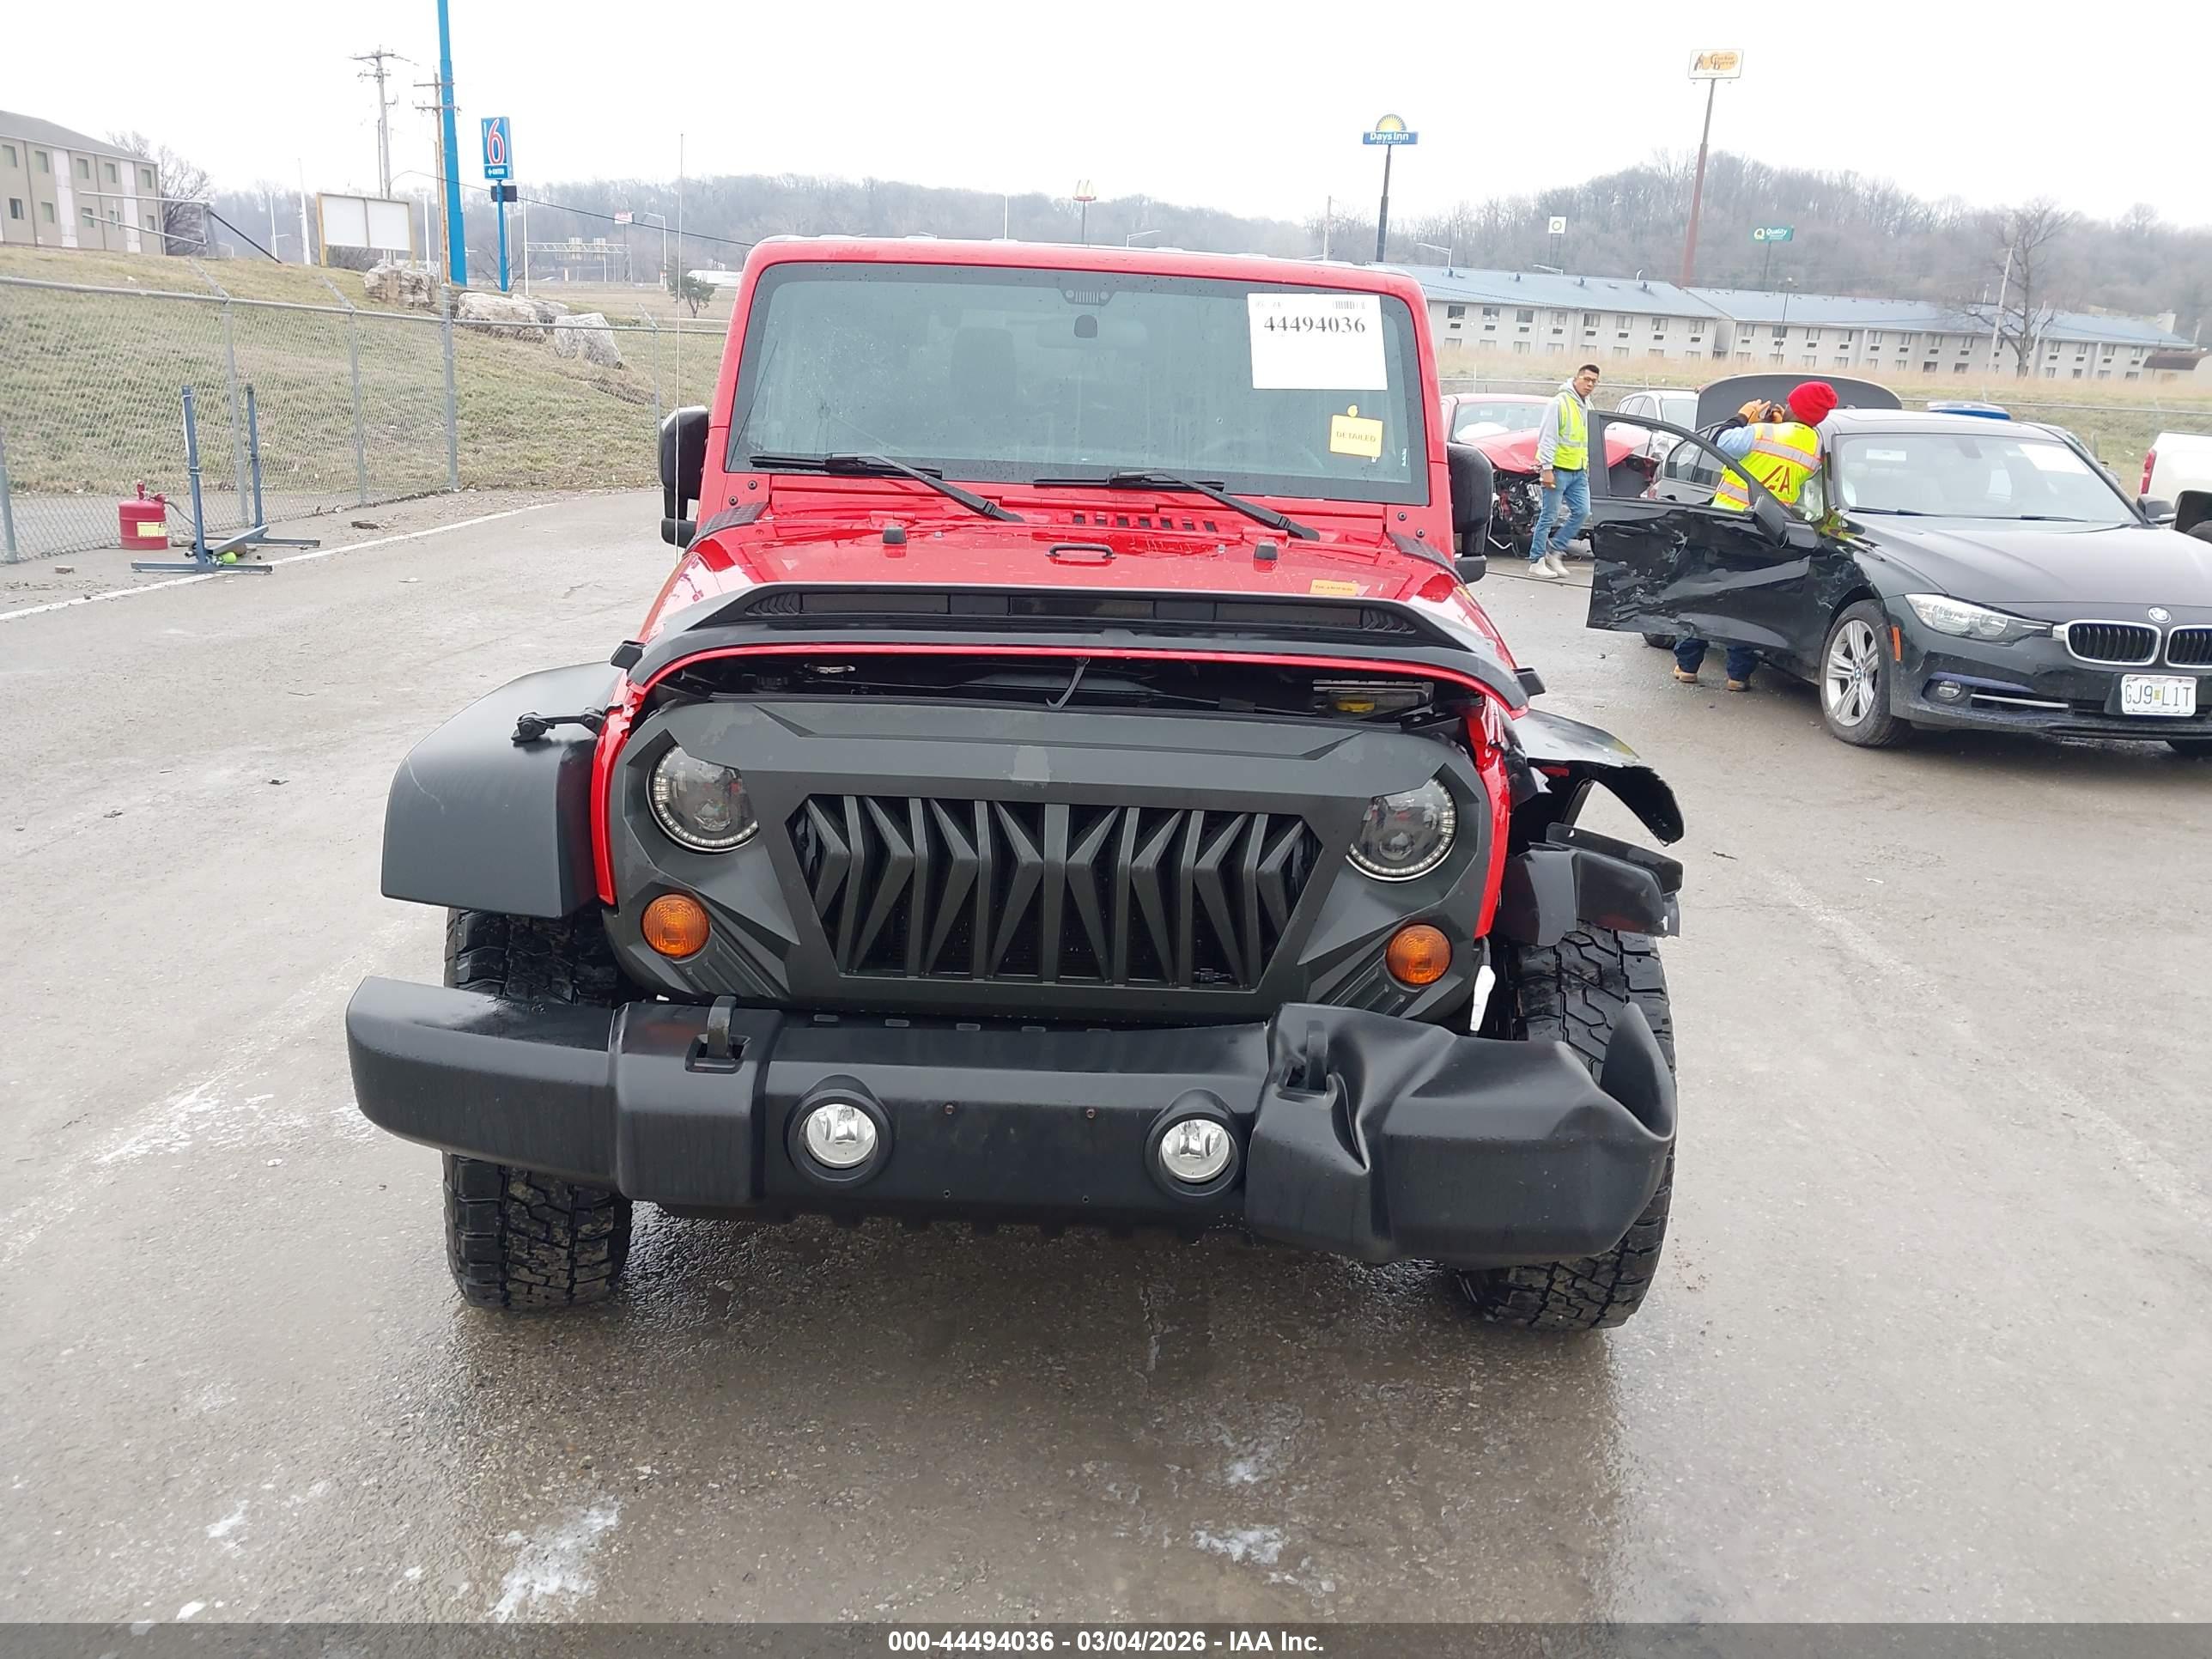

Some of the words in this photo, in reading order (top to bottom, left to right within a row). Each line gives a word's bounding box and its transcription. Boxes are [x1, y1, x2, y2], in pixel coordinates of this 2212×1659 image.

[487, 118, 505, 165] 6
[1370, 131, 1393, 142] Days
[1394, 131, 1409, 141] Inn
[1766, 228, 1787, 237] Quality
[1263, 315, 1366, 333] 44494036
[1336, 431, 1376, 442] DETAILED
[2125, 684, 2154, 705] GJ9
